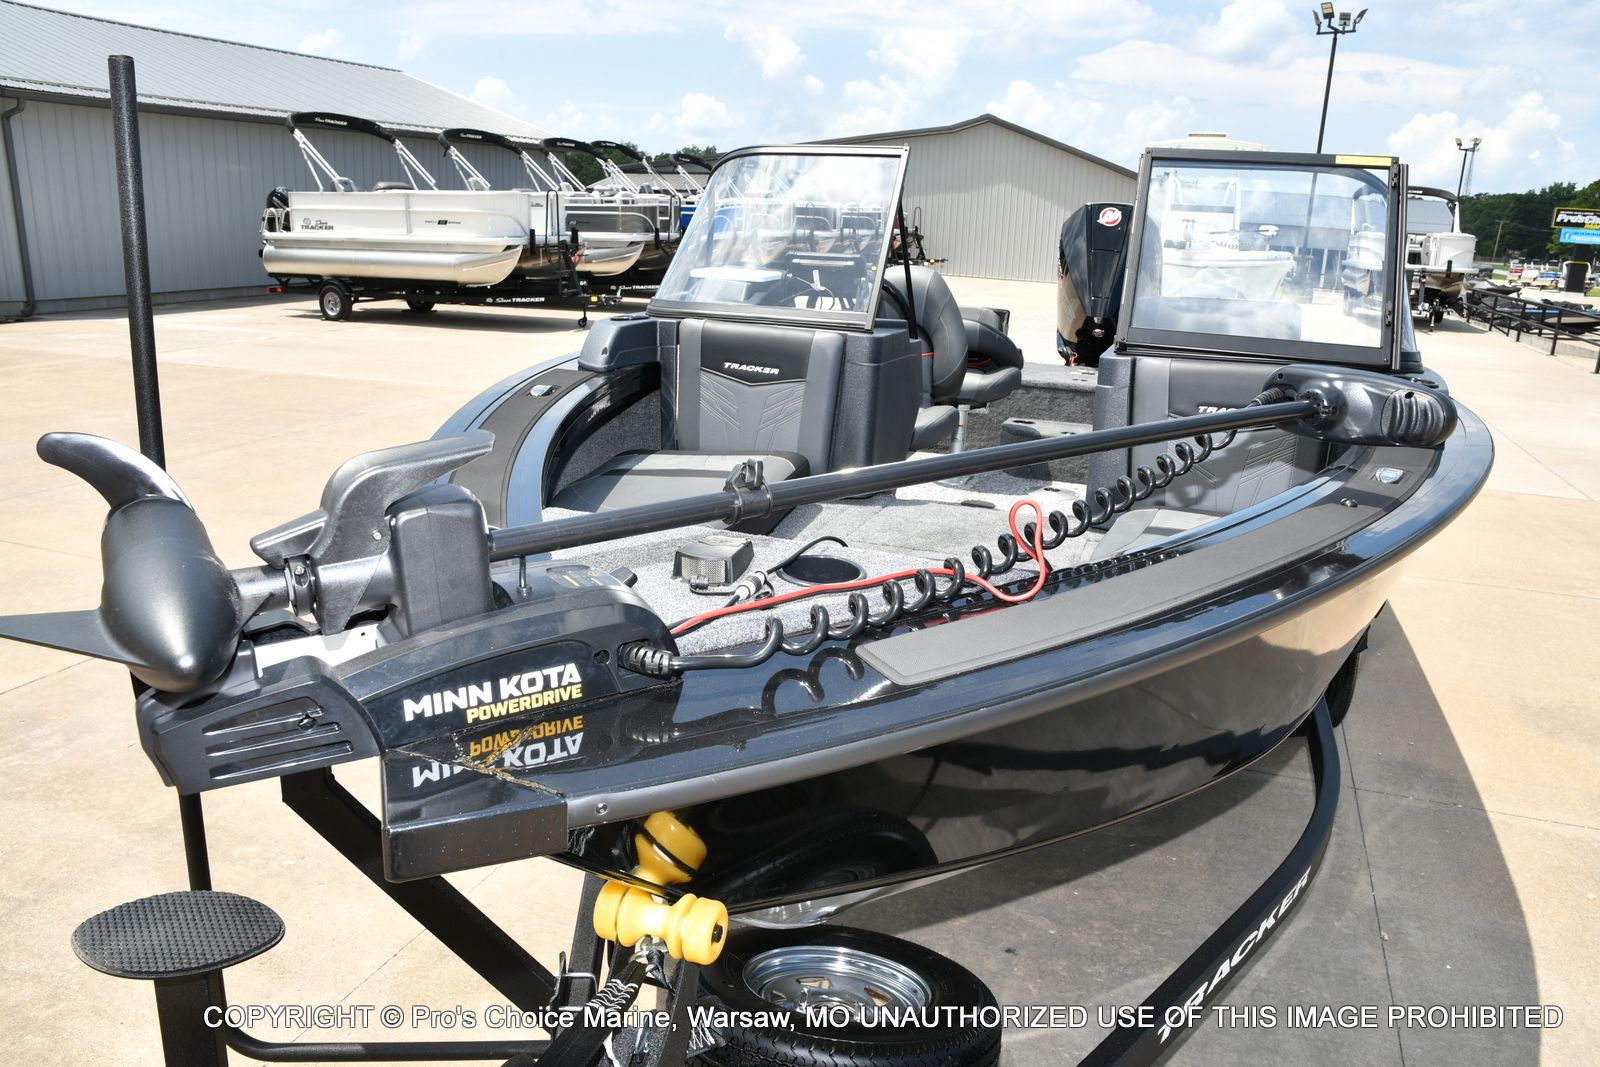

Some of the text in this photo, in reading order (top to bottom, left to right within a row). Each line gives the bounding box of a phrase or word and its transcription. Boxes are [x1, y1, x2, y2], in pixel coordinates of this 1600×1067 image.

[723, 361, 780, 375] TRACKER
[402, 662, 583, 723] MINN KOTA
[466, 683, 583, 724] POWERDRIVE
